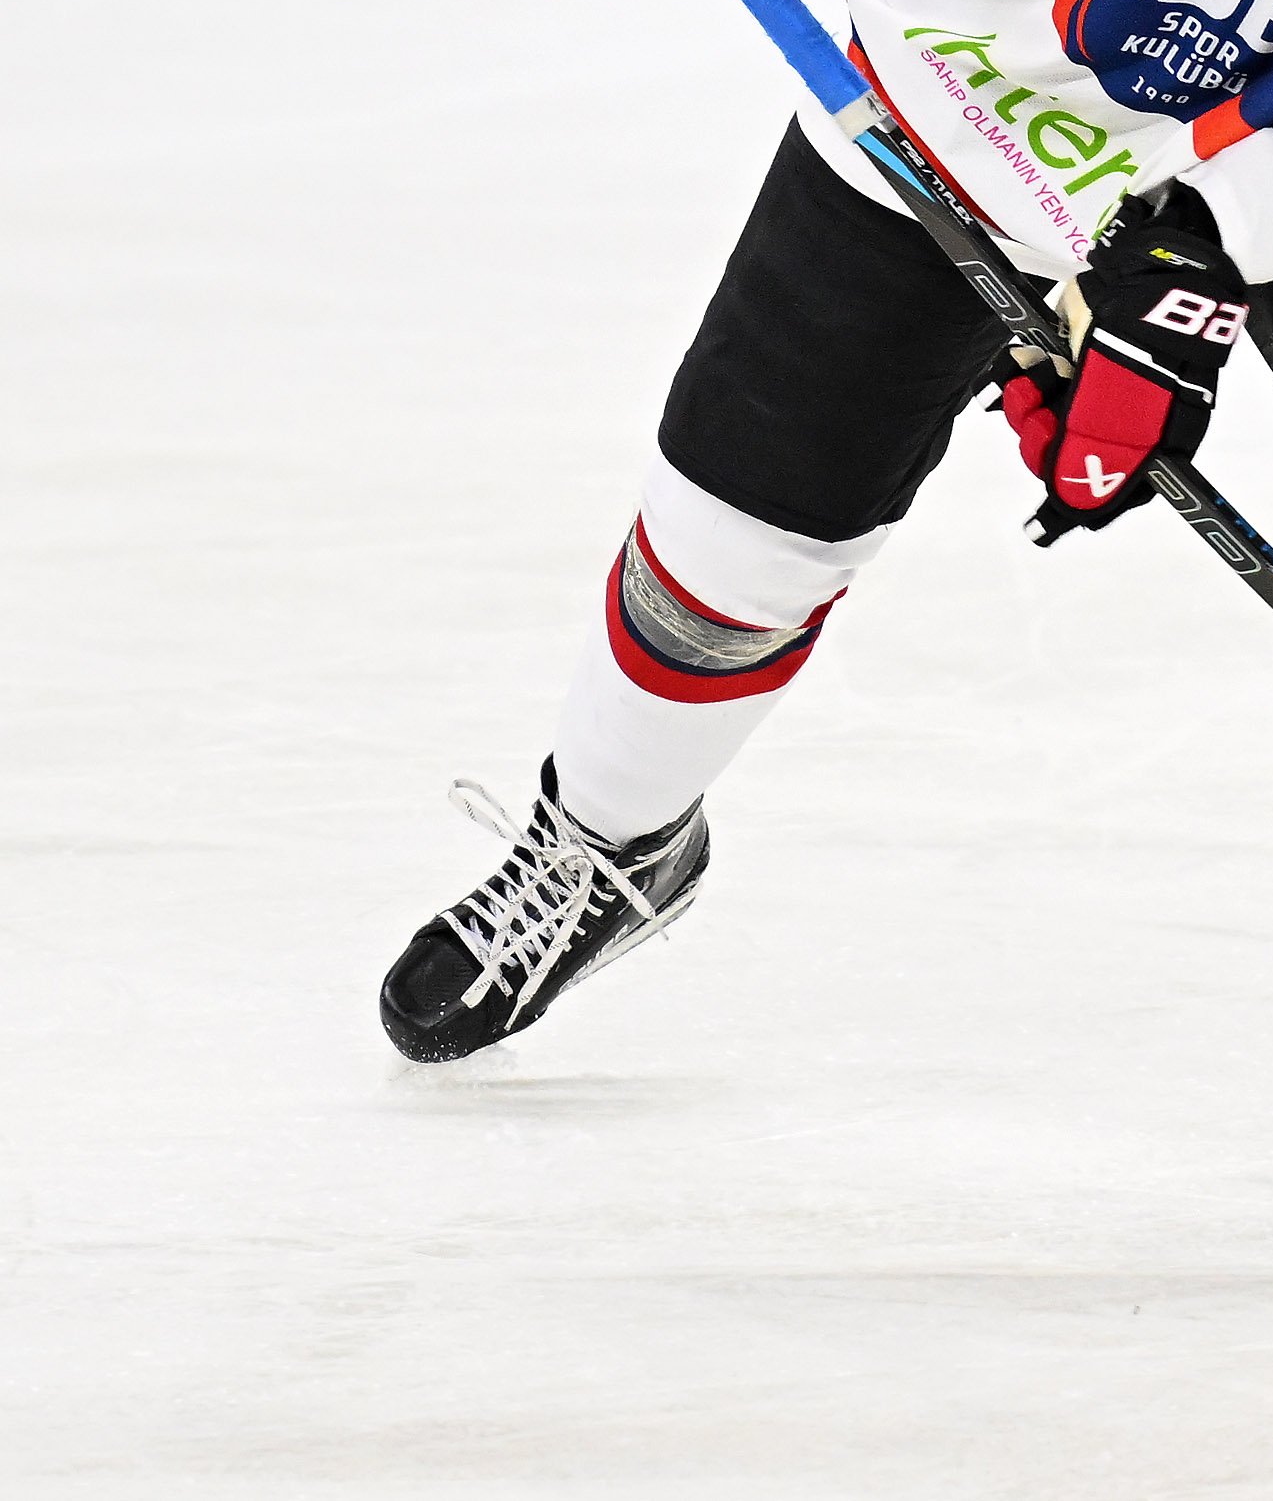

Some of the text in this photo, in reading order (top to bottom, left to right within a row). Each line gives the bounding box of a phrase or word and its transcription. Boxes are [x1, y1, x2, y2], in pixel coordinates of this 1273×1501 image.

[1120, 34, 1249, 96] KULÜBÜ
[1157, 11, 1241, 71] SPOR
[1130, 75, 1191, 105] 1990
[961, 104, 1041, 186] OLMANIN
